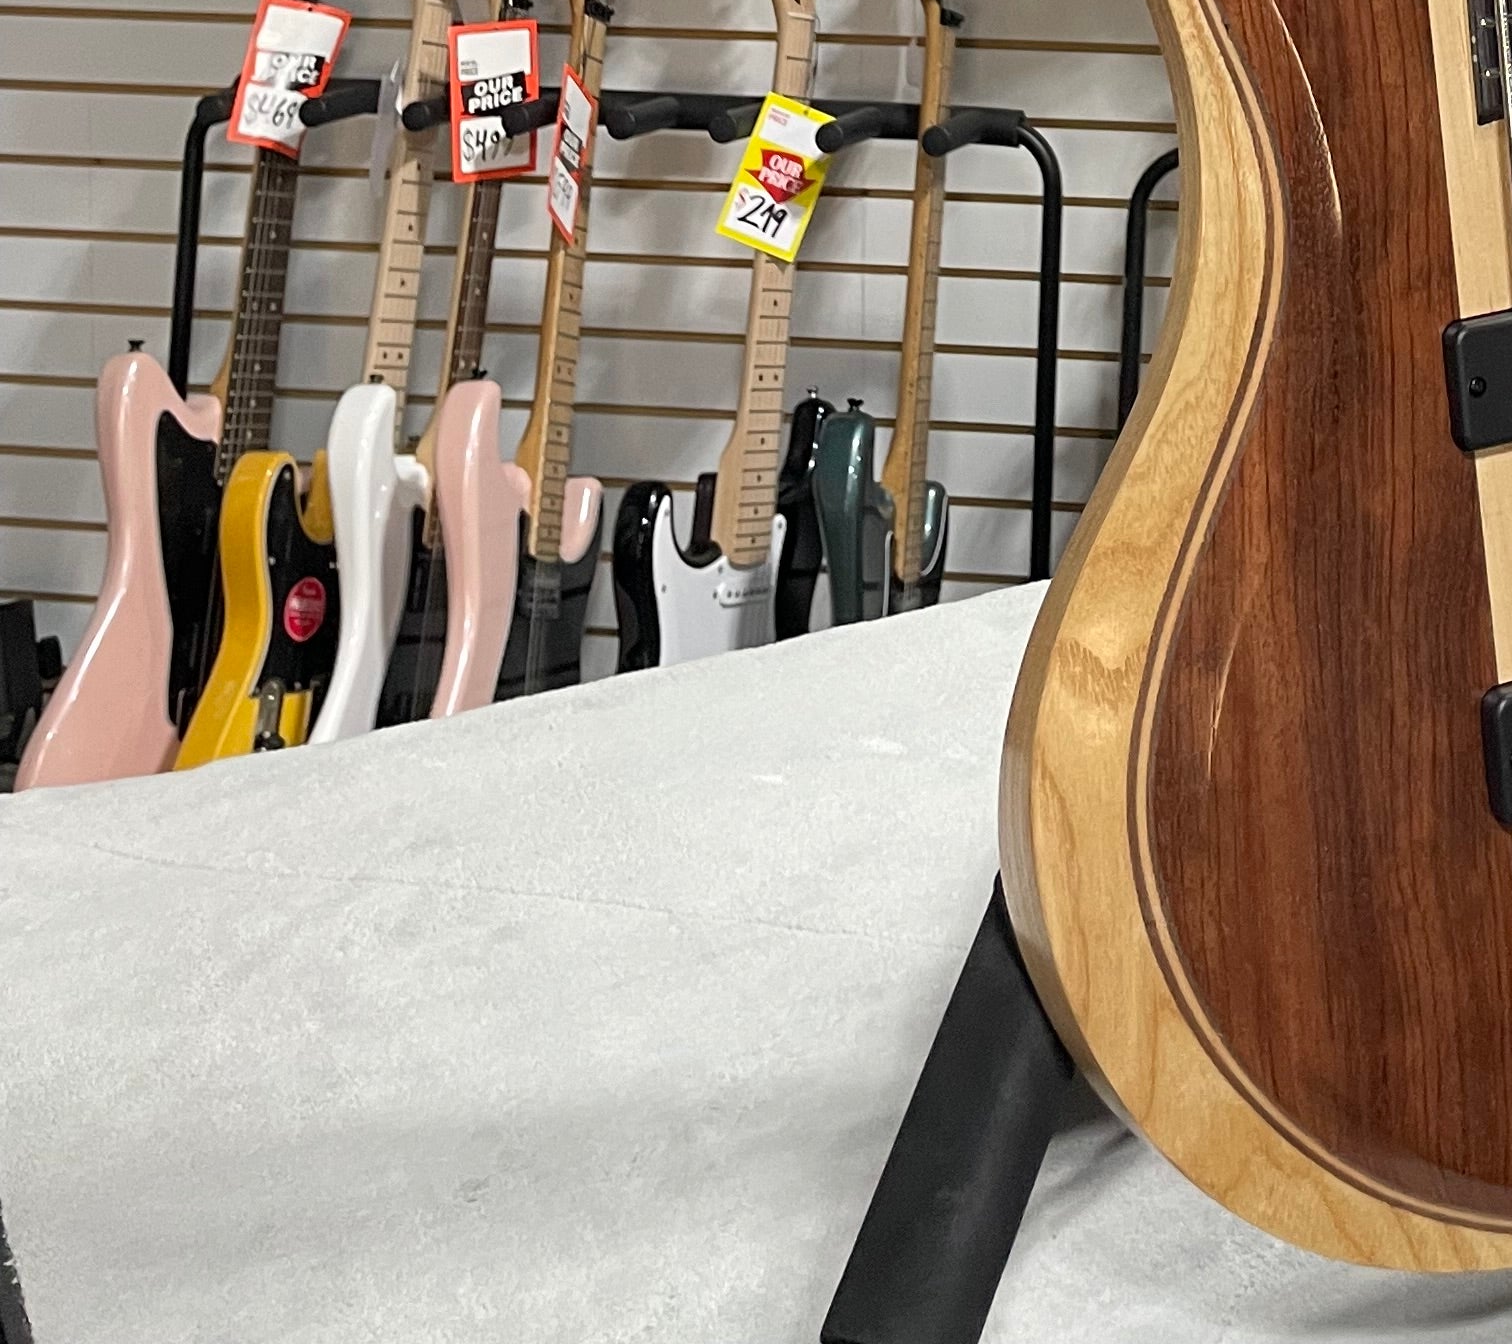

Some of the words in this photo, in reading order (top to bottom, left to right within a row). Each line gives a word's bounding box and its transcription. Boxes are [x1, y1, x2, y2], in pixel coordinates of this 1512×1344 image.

[473, 74, 514, 97] OUR
[468, 85, 524, 115] PRICE
[768, 153, 803, 179] OUR
